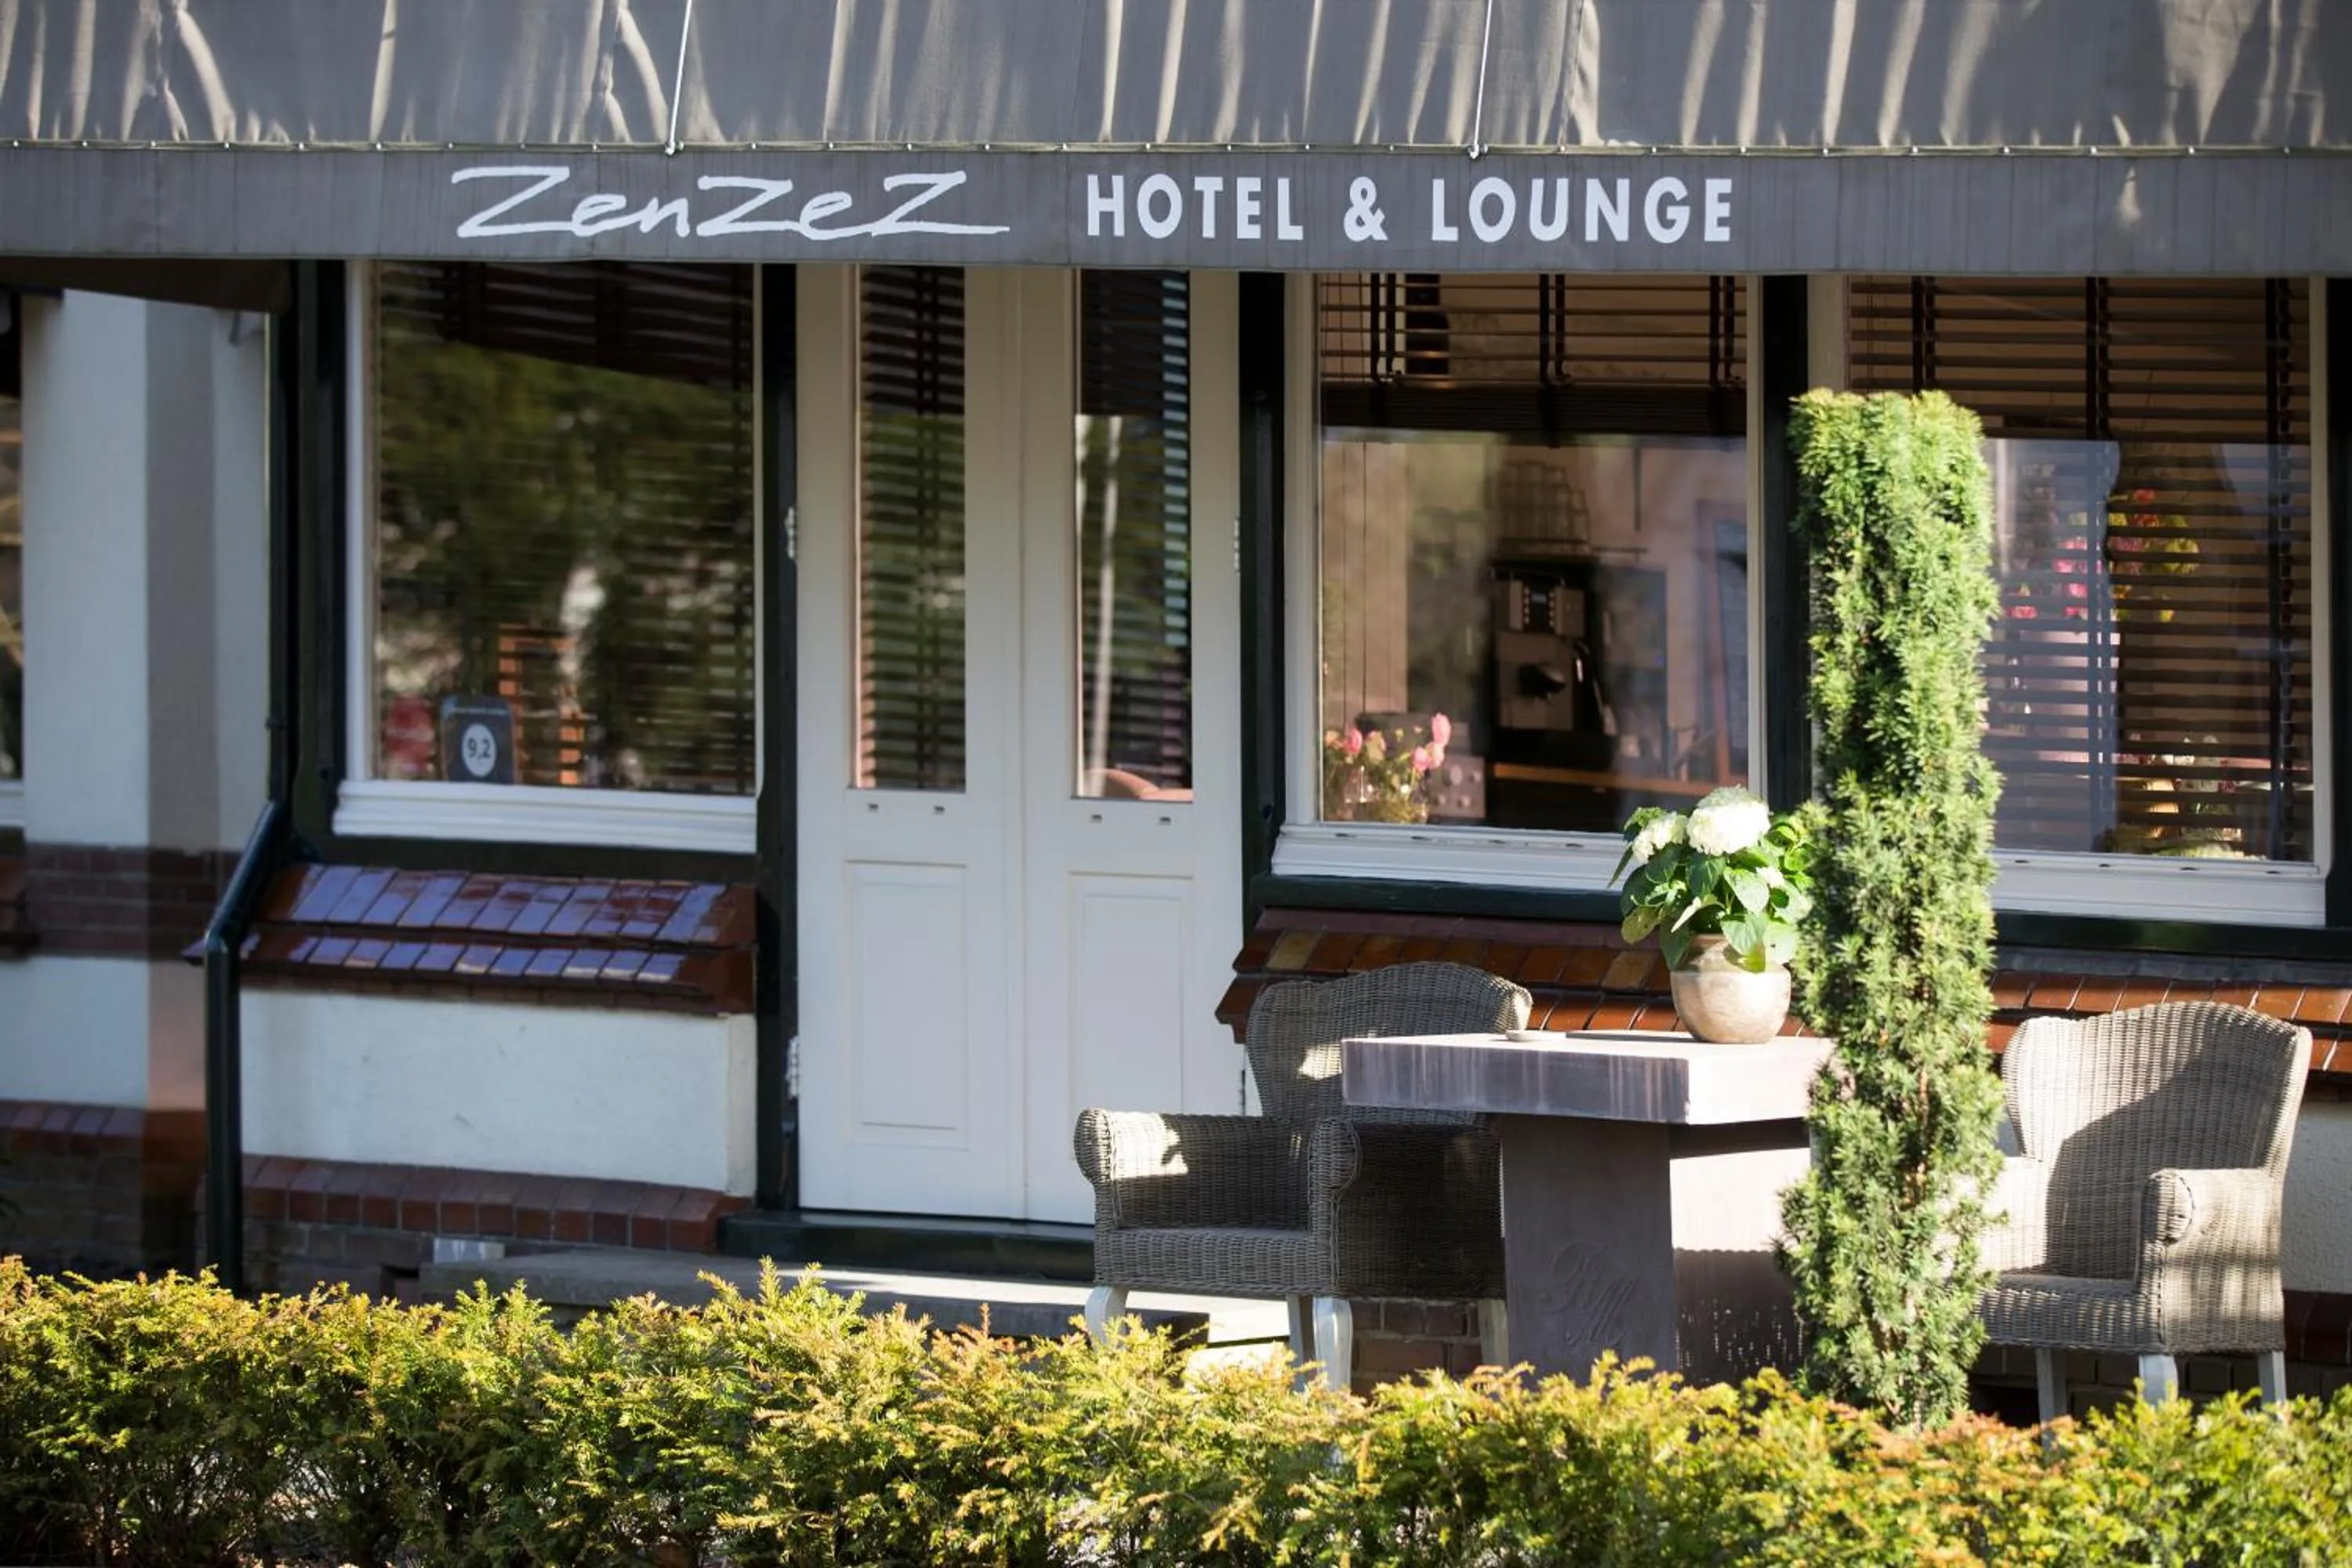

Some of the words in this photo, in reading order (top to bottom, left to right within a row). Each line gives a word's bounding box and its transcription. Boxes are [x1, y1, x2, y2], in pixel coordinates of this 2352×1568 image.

[1087, 172, 1305, 241] HOTEL
[1343, 176, 1388, 242] &
[1431, 176, 1733, 245] LOUNGE
